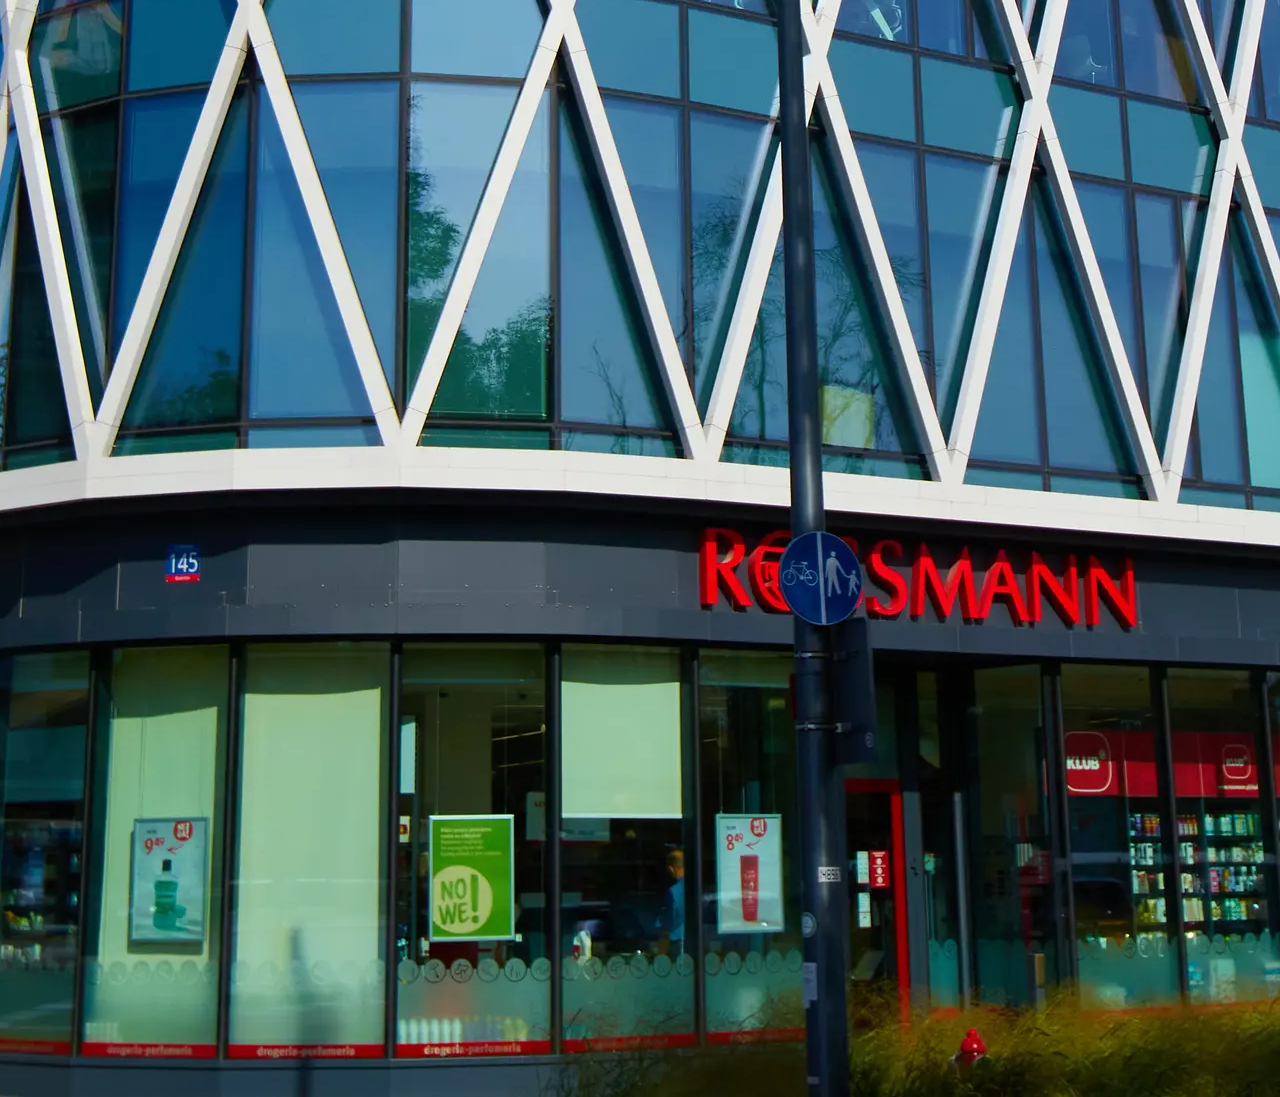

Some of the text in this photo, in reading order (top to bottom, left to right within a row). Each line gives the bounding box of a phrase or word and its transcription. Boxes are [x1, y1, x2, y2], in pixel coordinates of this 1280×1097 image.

[170, 552, 198, 573] 145
[1067, 756, 1100, 771] KLUB
[441, 878, 467, 902] NO
[256, 1045, 356, 1058] drogeria-perfumeria
